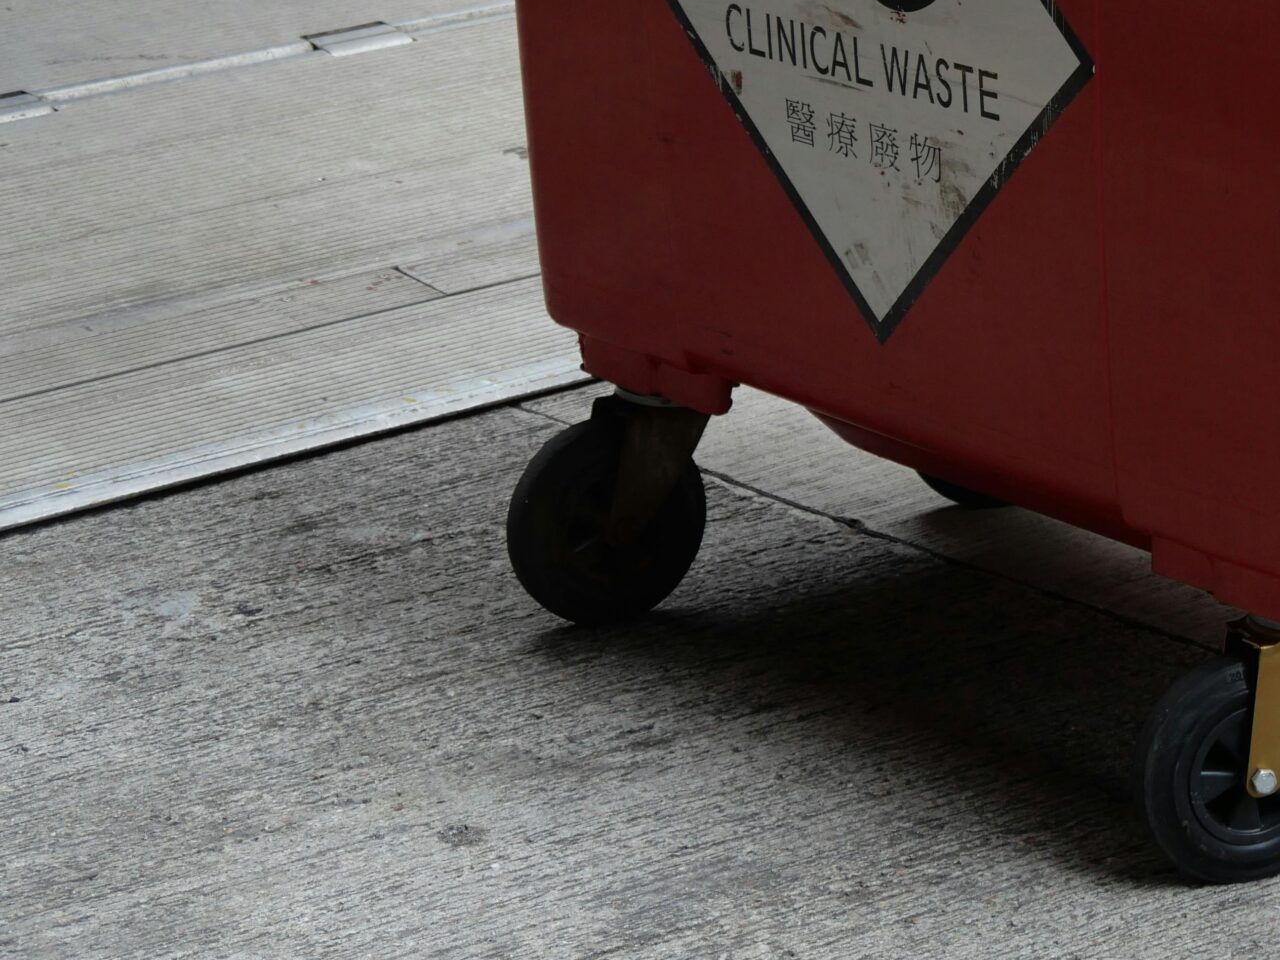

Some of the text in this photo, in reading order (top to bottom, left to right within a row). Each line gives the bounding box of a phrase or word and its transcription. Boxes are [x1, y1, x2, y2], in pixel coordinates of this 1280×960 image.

[725, 3, 1001, 122] CLINICAL WASTE
[785, 97, 943, 184] 醫療廢物
